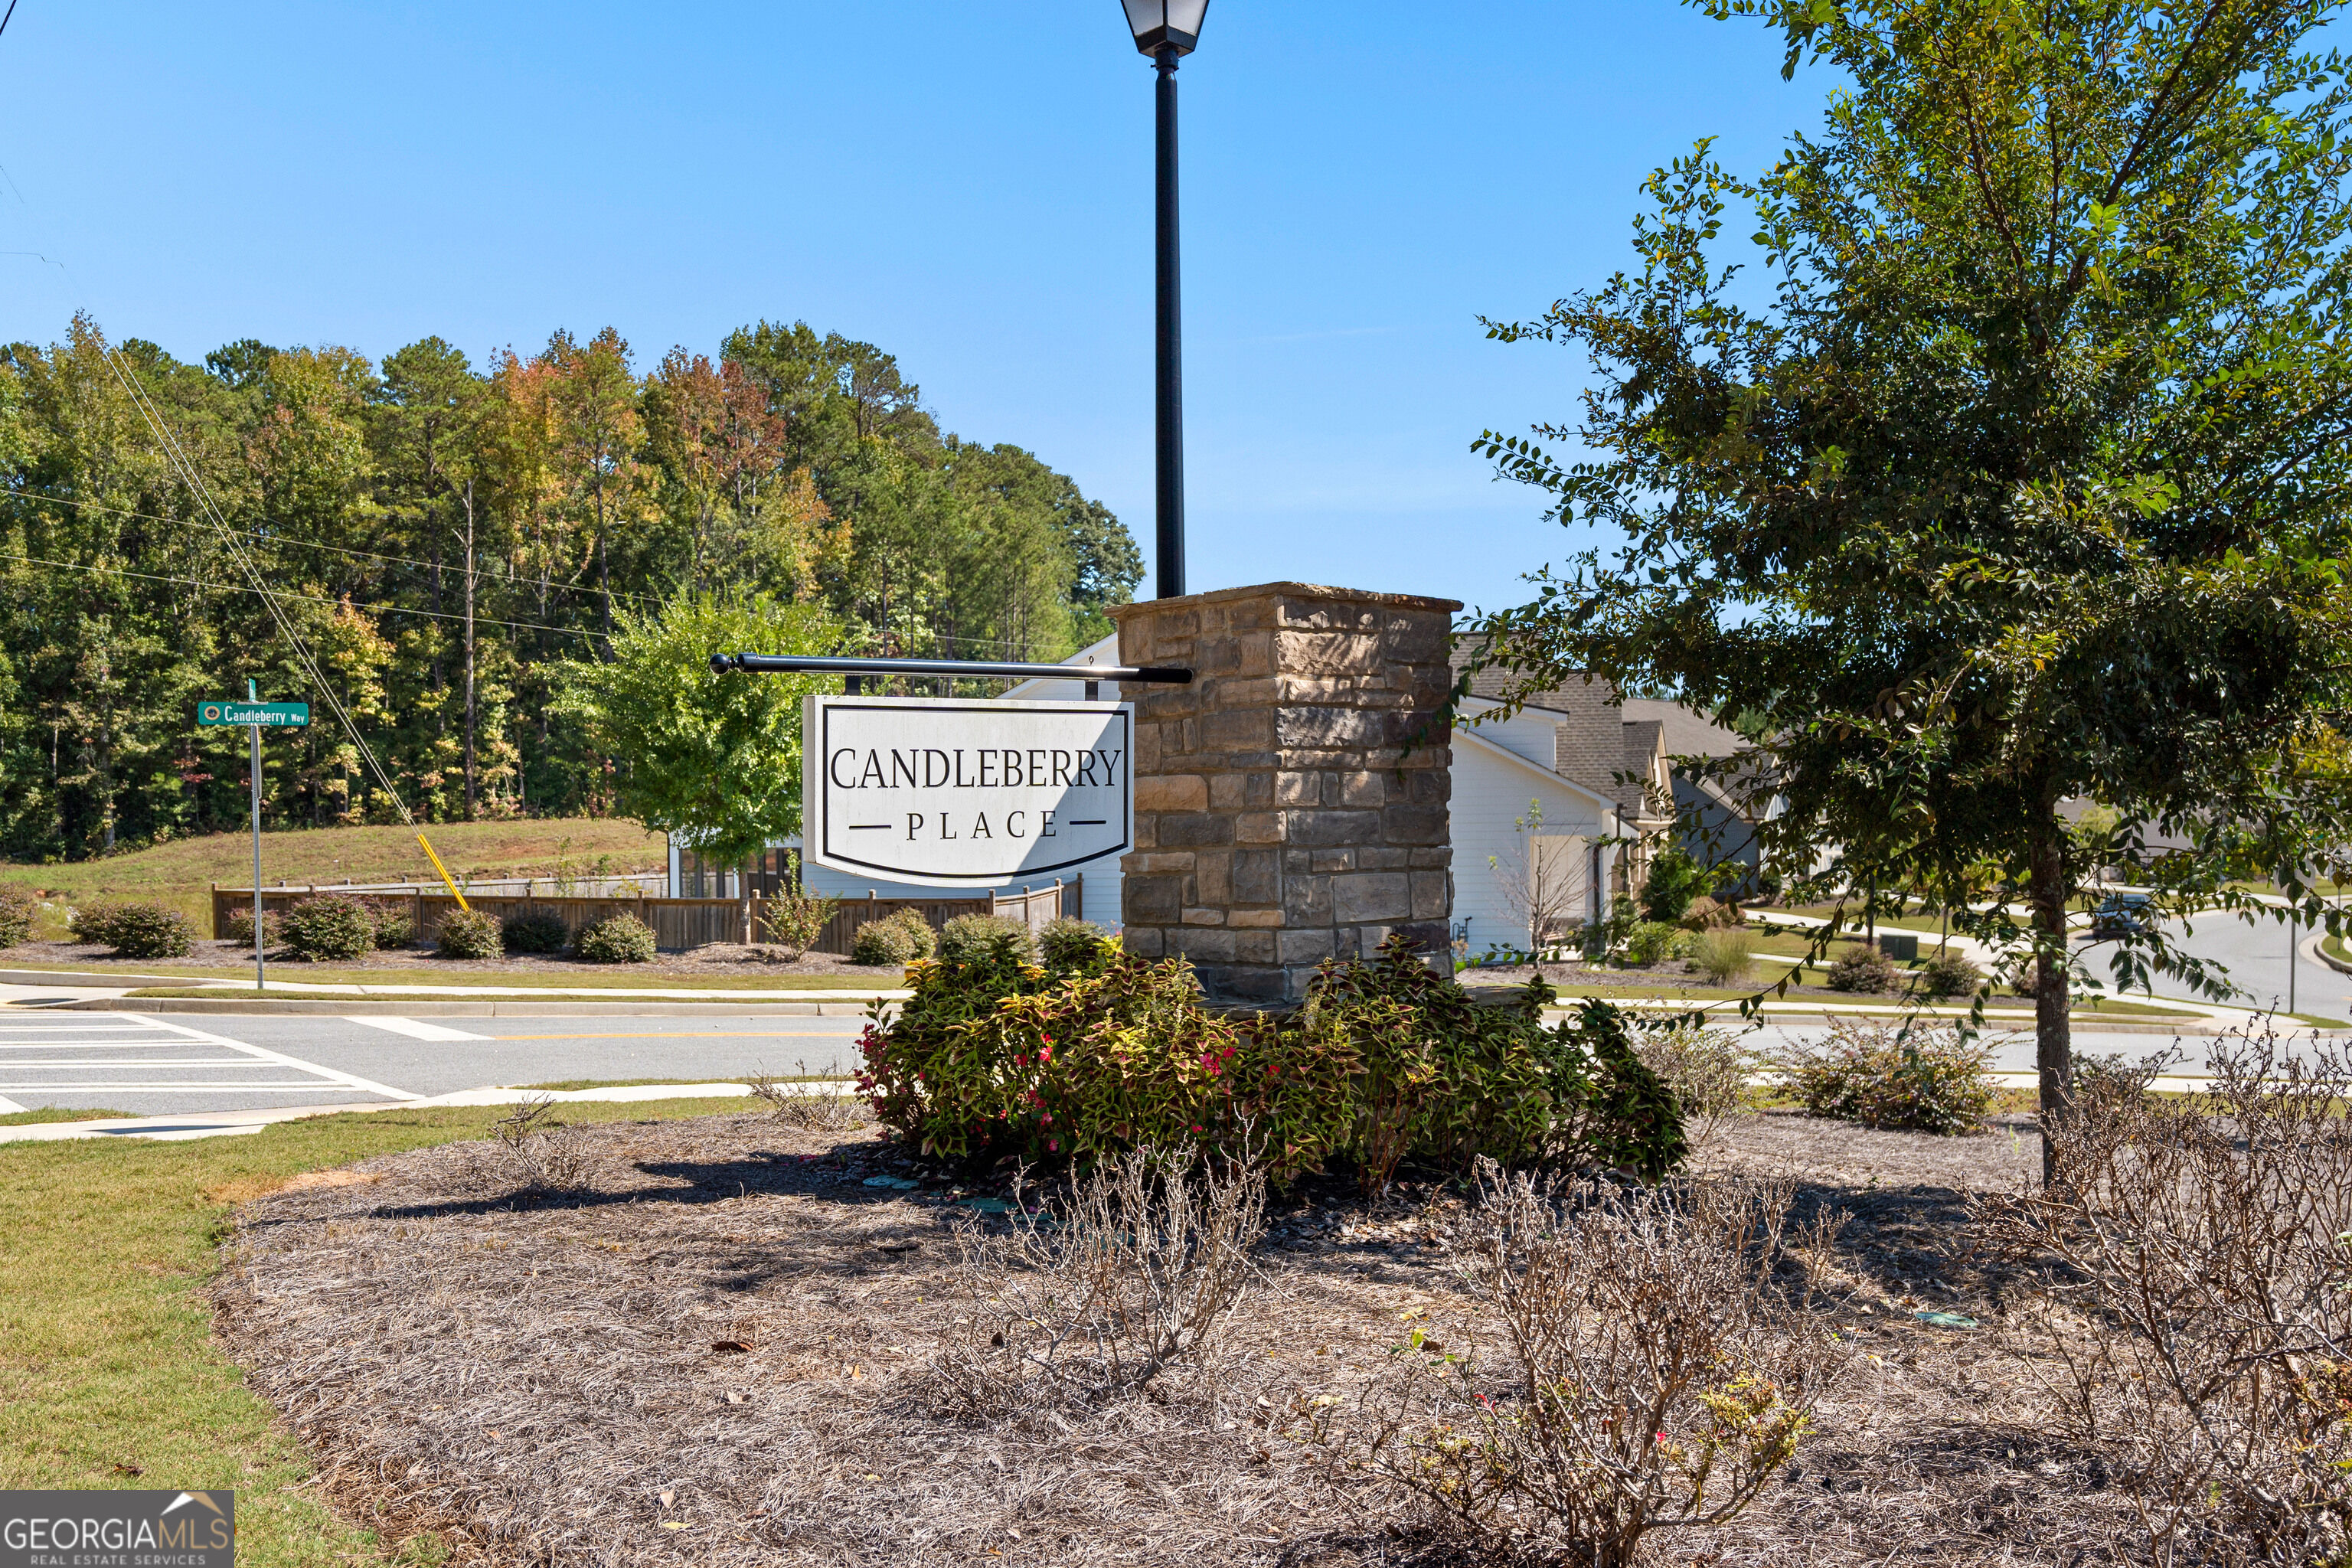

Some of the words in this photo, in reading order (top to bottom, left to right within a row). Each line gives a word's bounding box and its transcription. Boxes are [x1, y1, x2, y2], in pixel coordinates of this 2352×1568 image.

[224, 705, 286, 724] Candleberry
[291, 714, 305, 724] Way
[831, 748, 1121, 789] CANDLEBERRY
[906, 810, 1057, 841] PLACE
